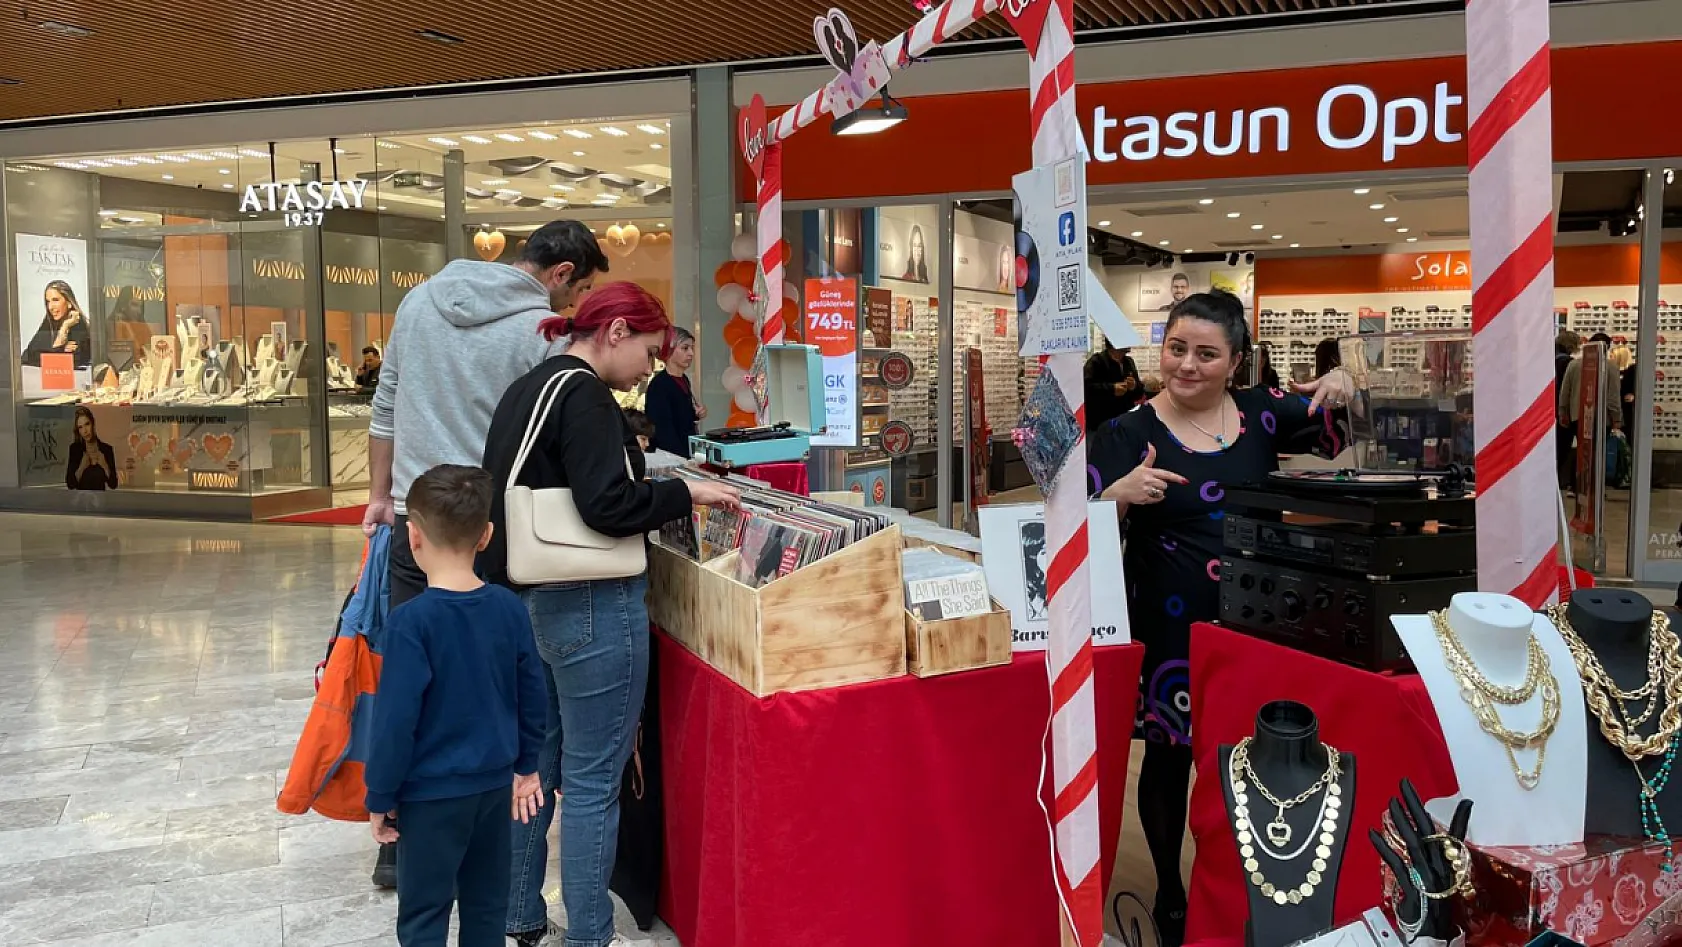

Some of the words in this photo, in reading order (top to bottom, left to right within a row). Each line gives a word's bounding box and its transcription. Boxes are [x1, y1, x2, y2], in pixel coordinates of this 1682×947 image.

[1317, 83, 1462, 163] Opt
[239, 179, 368, 212] ATASAY
[1411, 253, 1468, 280] Sola
[825, 374, 845, 388] GK
[915, 582, 928, 599] All
[928, 580, 949, 597] The
[949, 578, 983, 596] Things
[942, 598, 963, 614] She
[963, 594, 985, 611] Said
